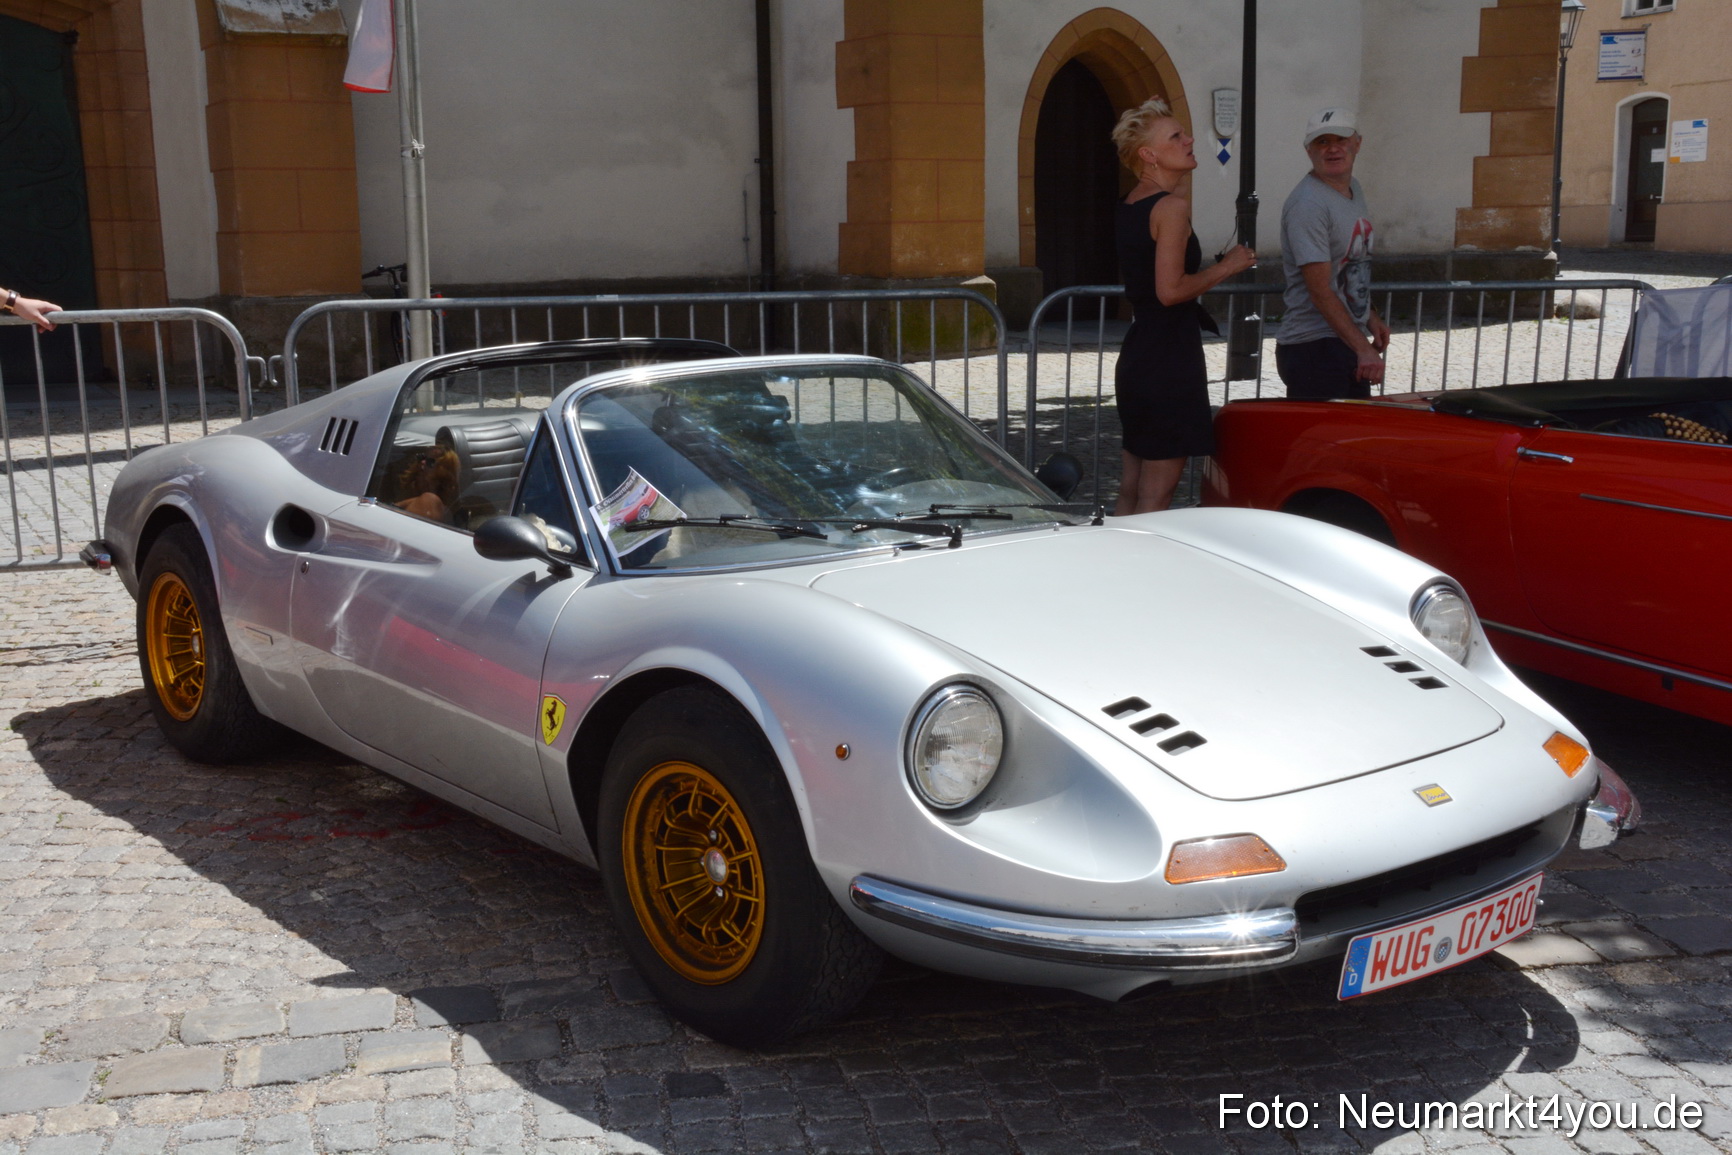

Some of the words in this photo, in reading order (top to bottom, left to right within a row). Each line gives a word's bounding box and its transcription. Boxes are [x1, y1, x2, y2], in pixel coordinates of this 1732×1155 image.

[1369, 924, 1435, 985] WUG
[1456, 884, 1536, 956] 07300
[1348, 972, 1358, 987] D
